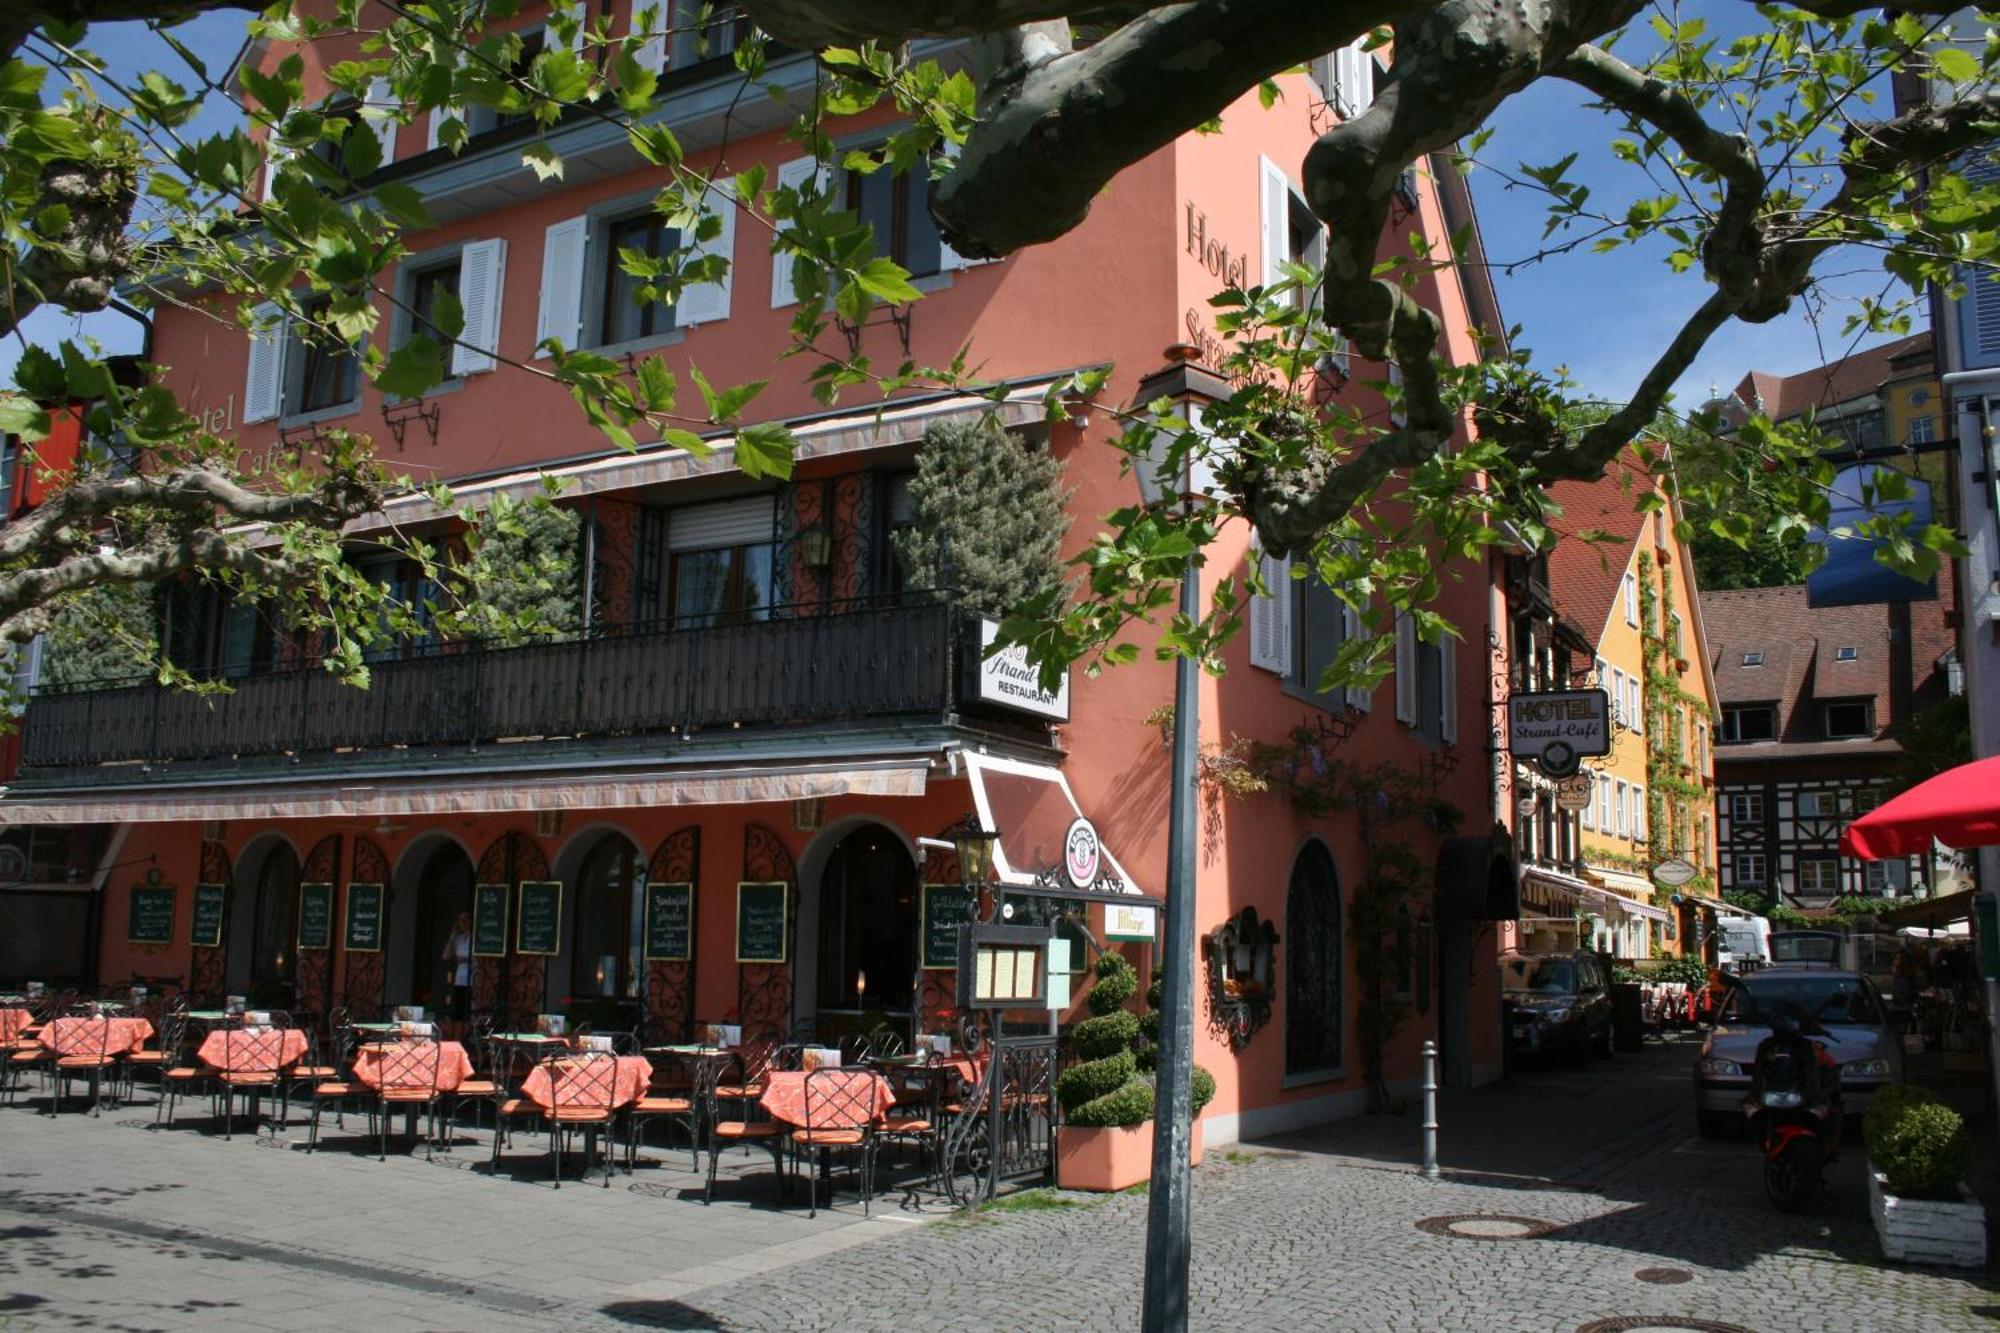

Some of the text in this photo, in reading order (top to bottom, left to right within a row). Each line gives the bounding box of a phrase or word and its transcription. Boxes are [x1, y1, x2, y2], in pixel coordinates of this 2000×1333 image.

[1185, 200, 1248, 292] Hotel
[189, 394, 234, 432] otel
[998, 680, 1057, 706] RESTAURANT
[1516, 697, 1600, 722] HOTEL
[1515, 723, 1600, 739] Strand-Café
